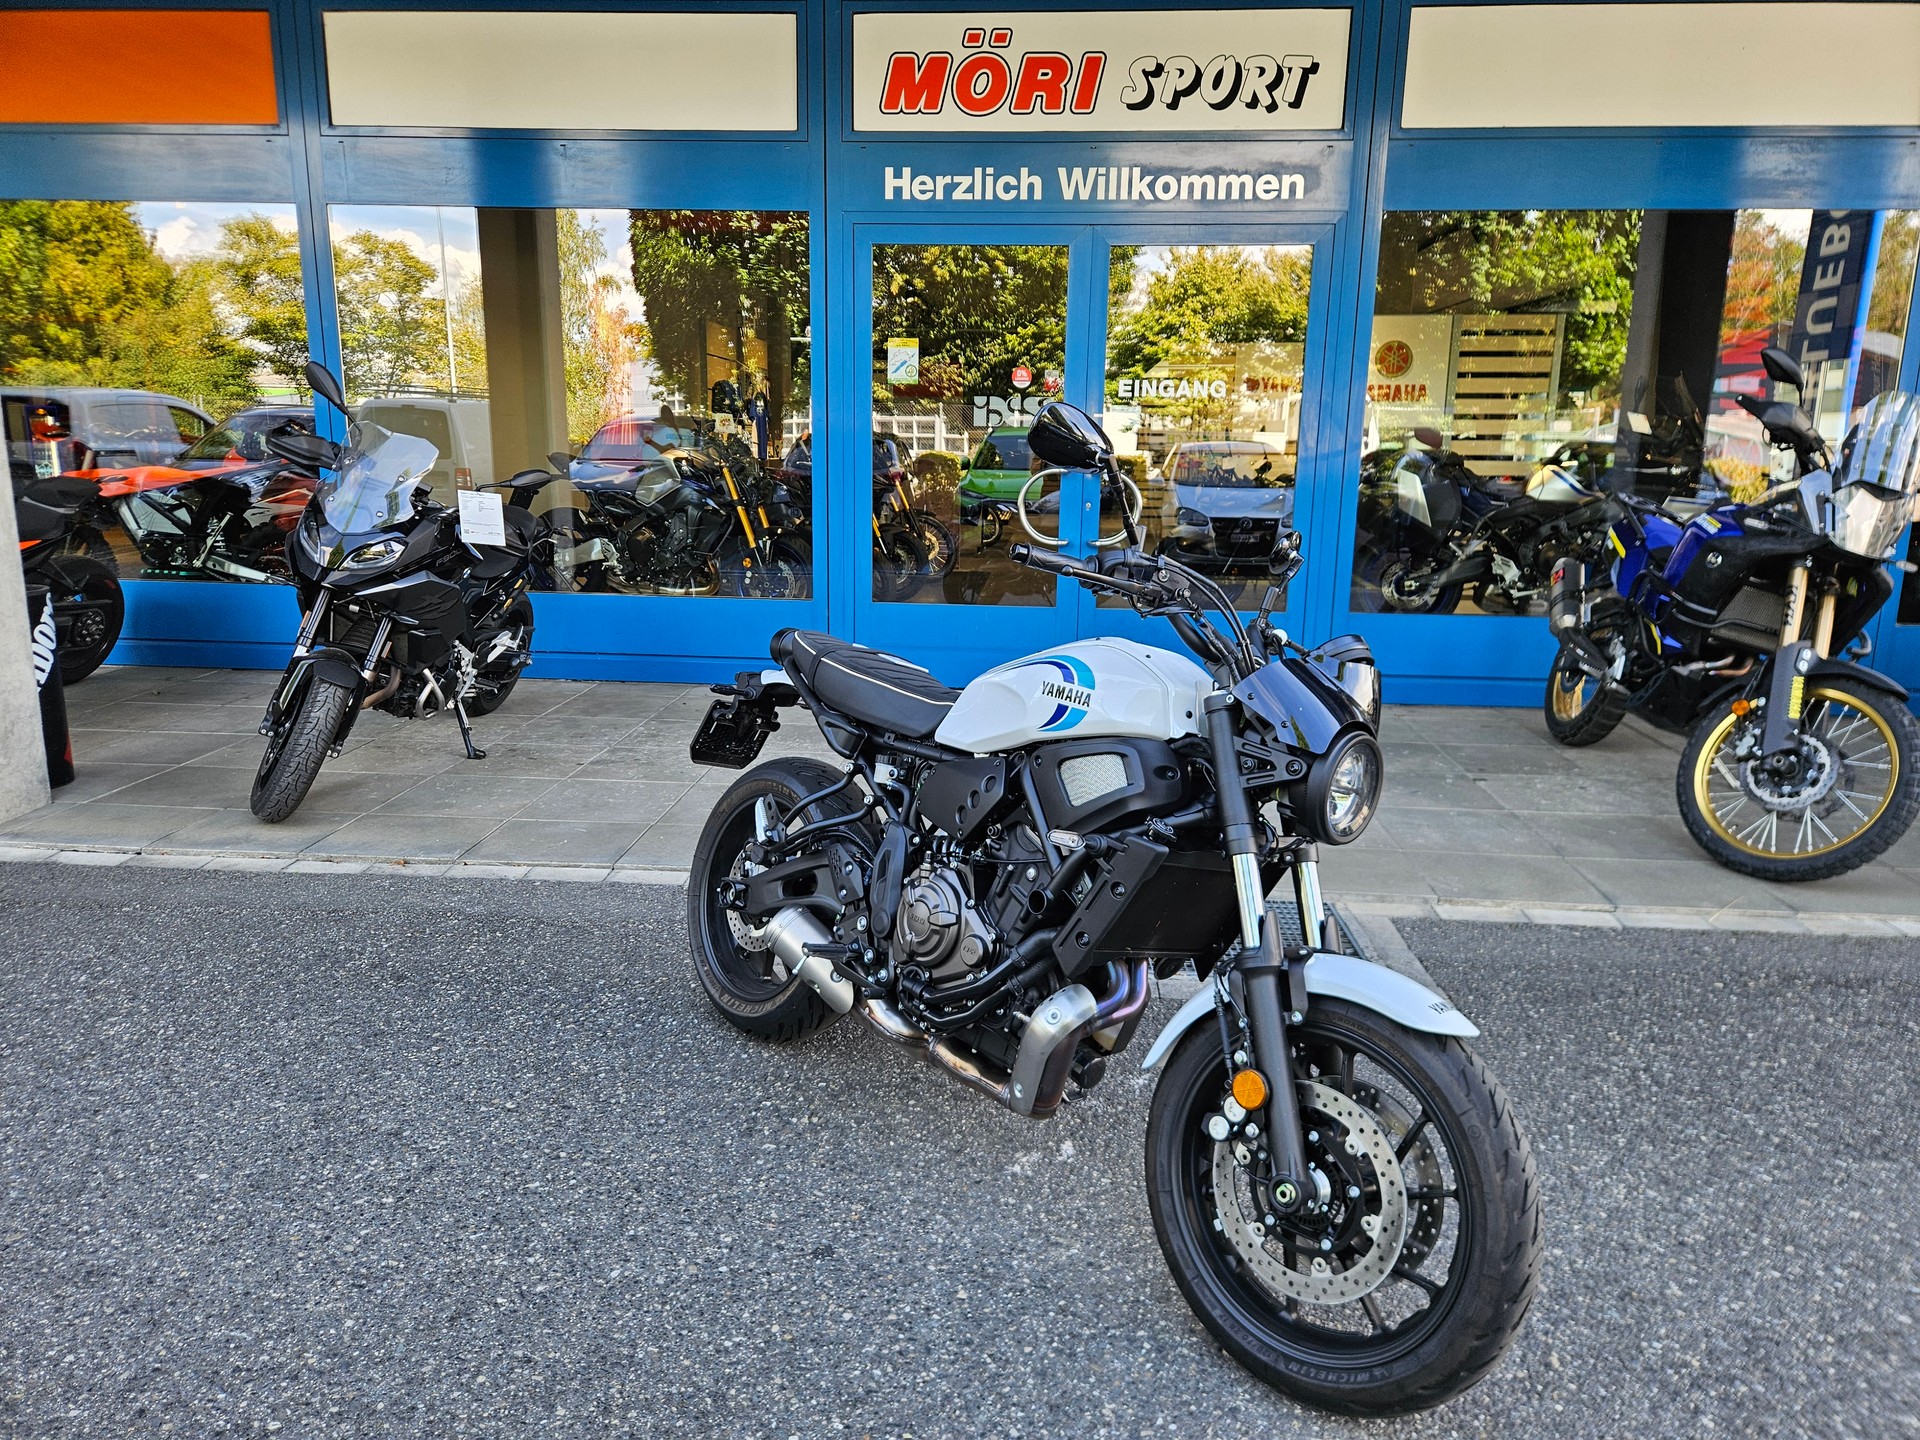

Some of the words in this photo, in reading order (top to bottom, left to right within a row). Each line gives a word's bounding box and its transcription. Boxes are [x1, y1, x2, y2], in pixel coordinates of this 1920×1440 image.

[879, 28, 1107, 117] MÖRI
[1120, 54, 1320, 113] SPORT
[884, 166, 1042, 200] Herzlich
[1058, 166, 1305, 200] Willkommen
[1118, 379, 1227, 398] EINGANG
[1042, 680, 1092, 708] YAMAHA
[720, 993, 774, 1014] MICHELIN
[1288, 1362, 1370, 1384] MICHELIN
